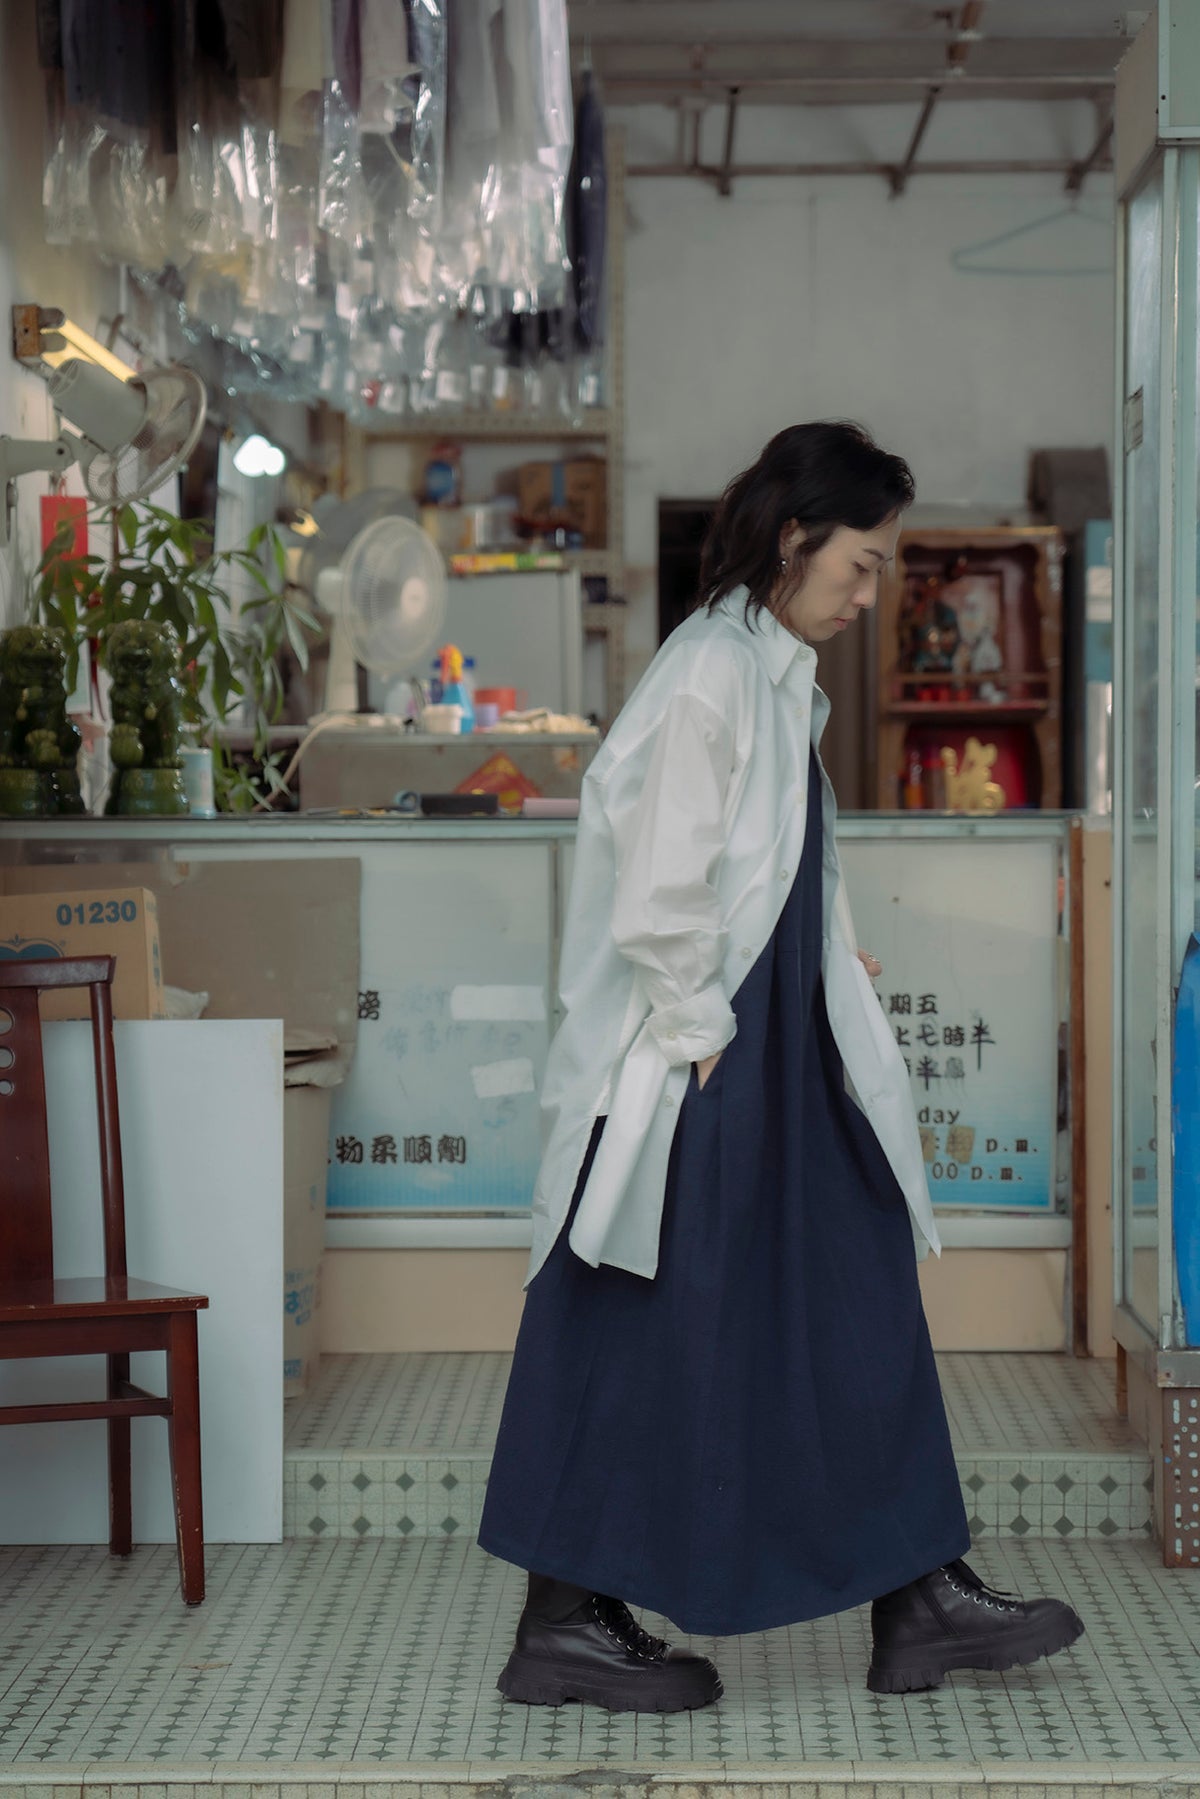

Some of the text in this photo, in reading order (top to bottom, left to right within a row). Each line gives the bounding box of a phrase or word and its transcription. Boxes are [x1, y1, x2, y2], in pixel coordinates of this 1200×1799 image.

[56, 900, 138, 926] 01230
[875, 992, 939, 1016] 期五
[327, 1134, 468, 1165] 物柔順劑
